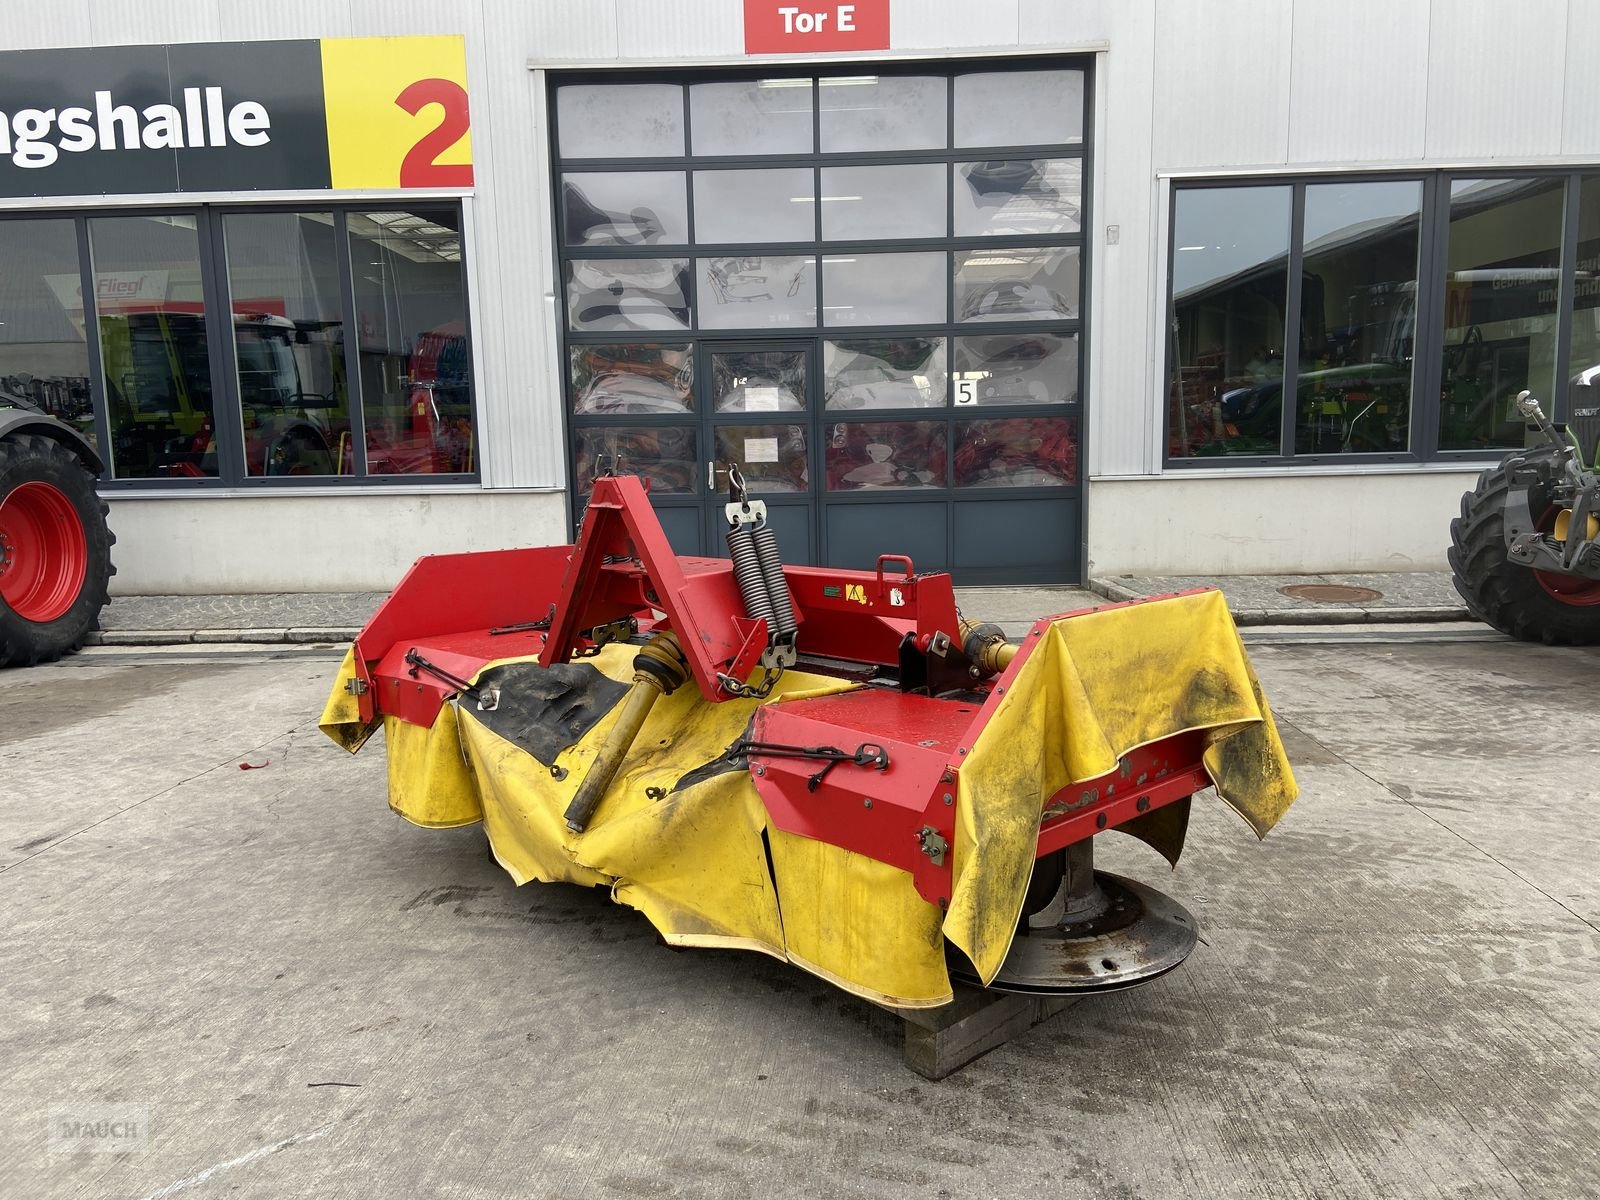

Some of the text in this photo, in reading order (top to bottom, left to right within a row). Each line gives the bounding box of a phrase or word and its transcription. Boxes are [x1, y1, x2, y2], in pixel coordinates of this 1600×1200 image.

[778, 5, 856, 34] Tor E
[0, 78, 475, 188] gshalle 2
[97, 276, 145, 295] Fliegl
[959, 383, 971, 404] 5
